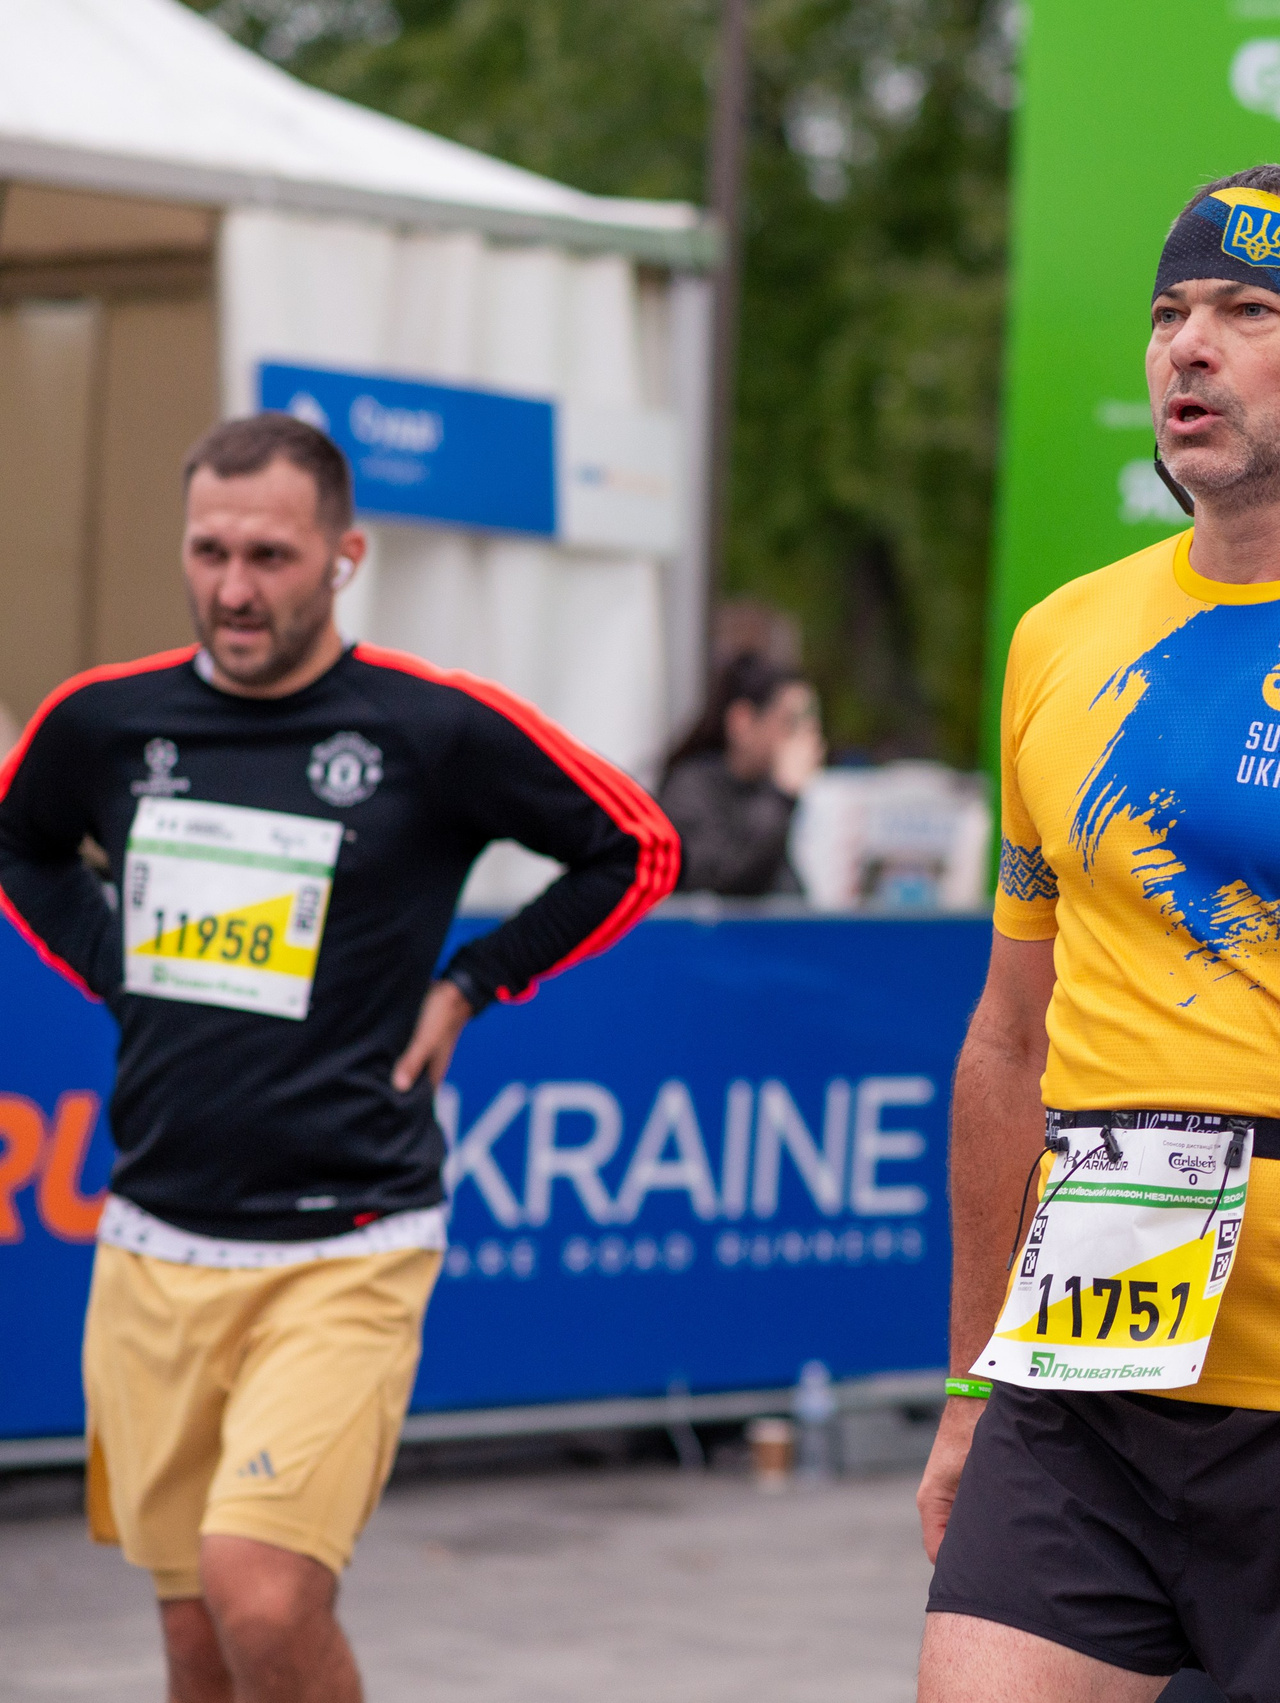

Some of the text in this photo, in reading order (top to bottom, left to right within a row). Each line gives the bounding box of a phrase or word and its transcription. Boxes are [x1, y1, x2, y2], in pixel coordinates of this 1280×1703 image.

[154, 908, 274, 966] 11958
[433, 1074, 936, 1230] KRAINE
[1082, 1150, 1124, 1161] UNDR
[1082, 1159, 1129, 1171] ARMOUR
[1168, 1152, 1216, 1174] Carlsberg
[1106, 1189, 1143, 1199] МАРАФОН
[1223, 1191, 1245, 1203] 2024
[1036, 1273, 1190, 1342] 11751
[1050, 1361, 1166, 1382] ПриватБанк
